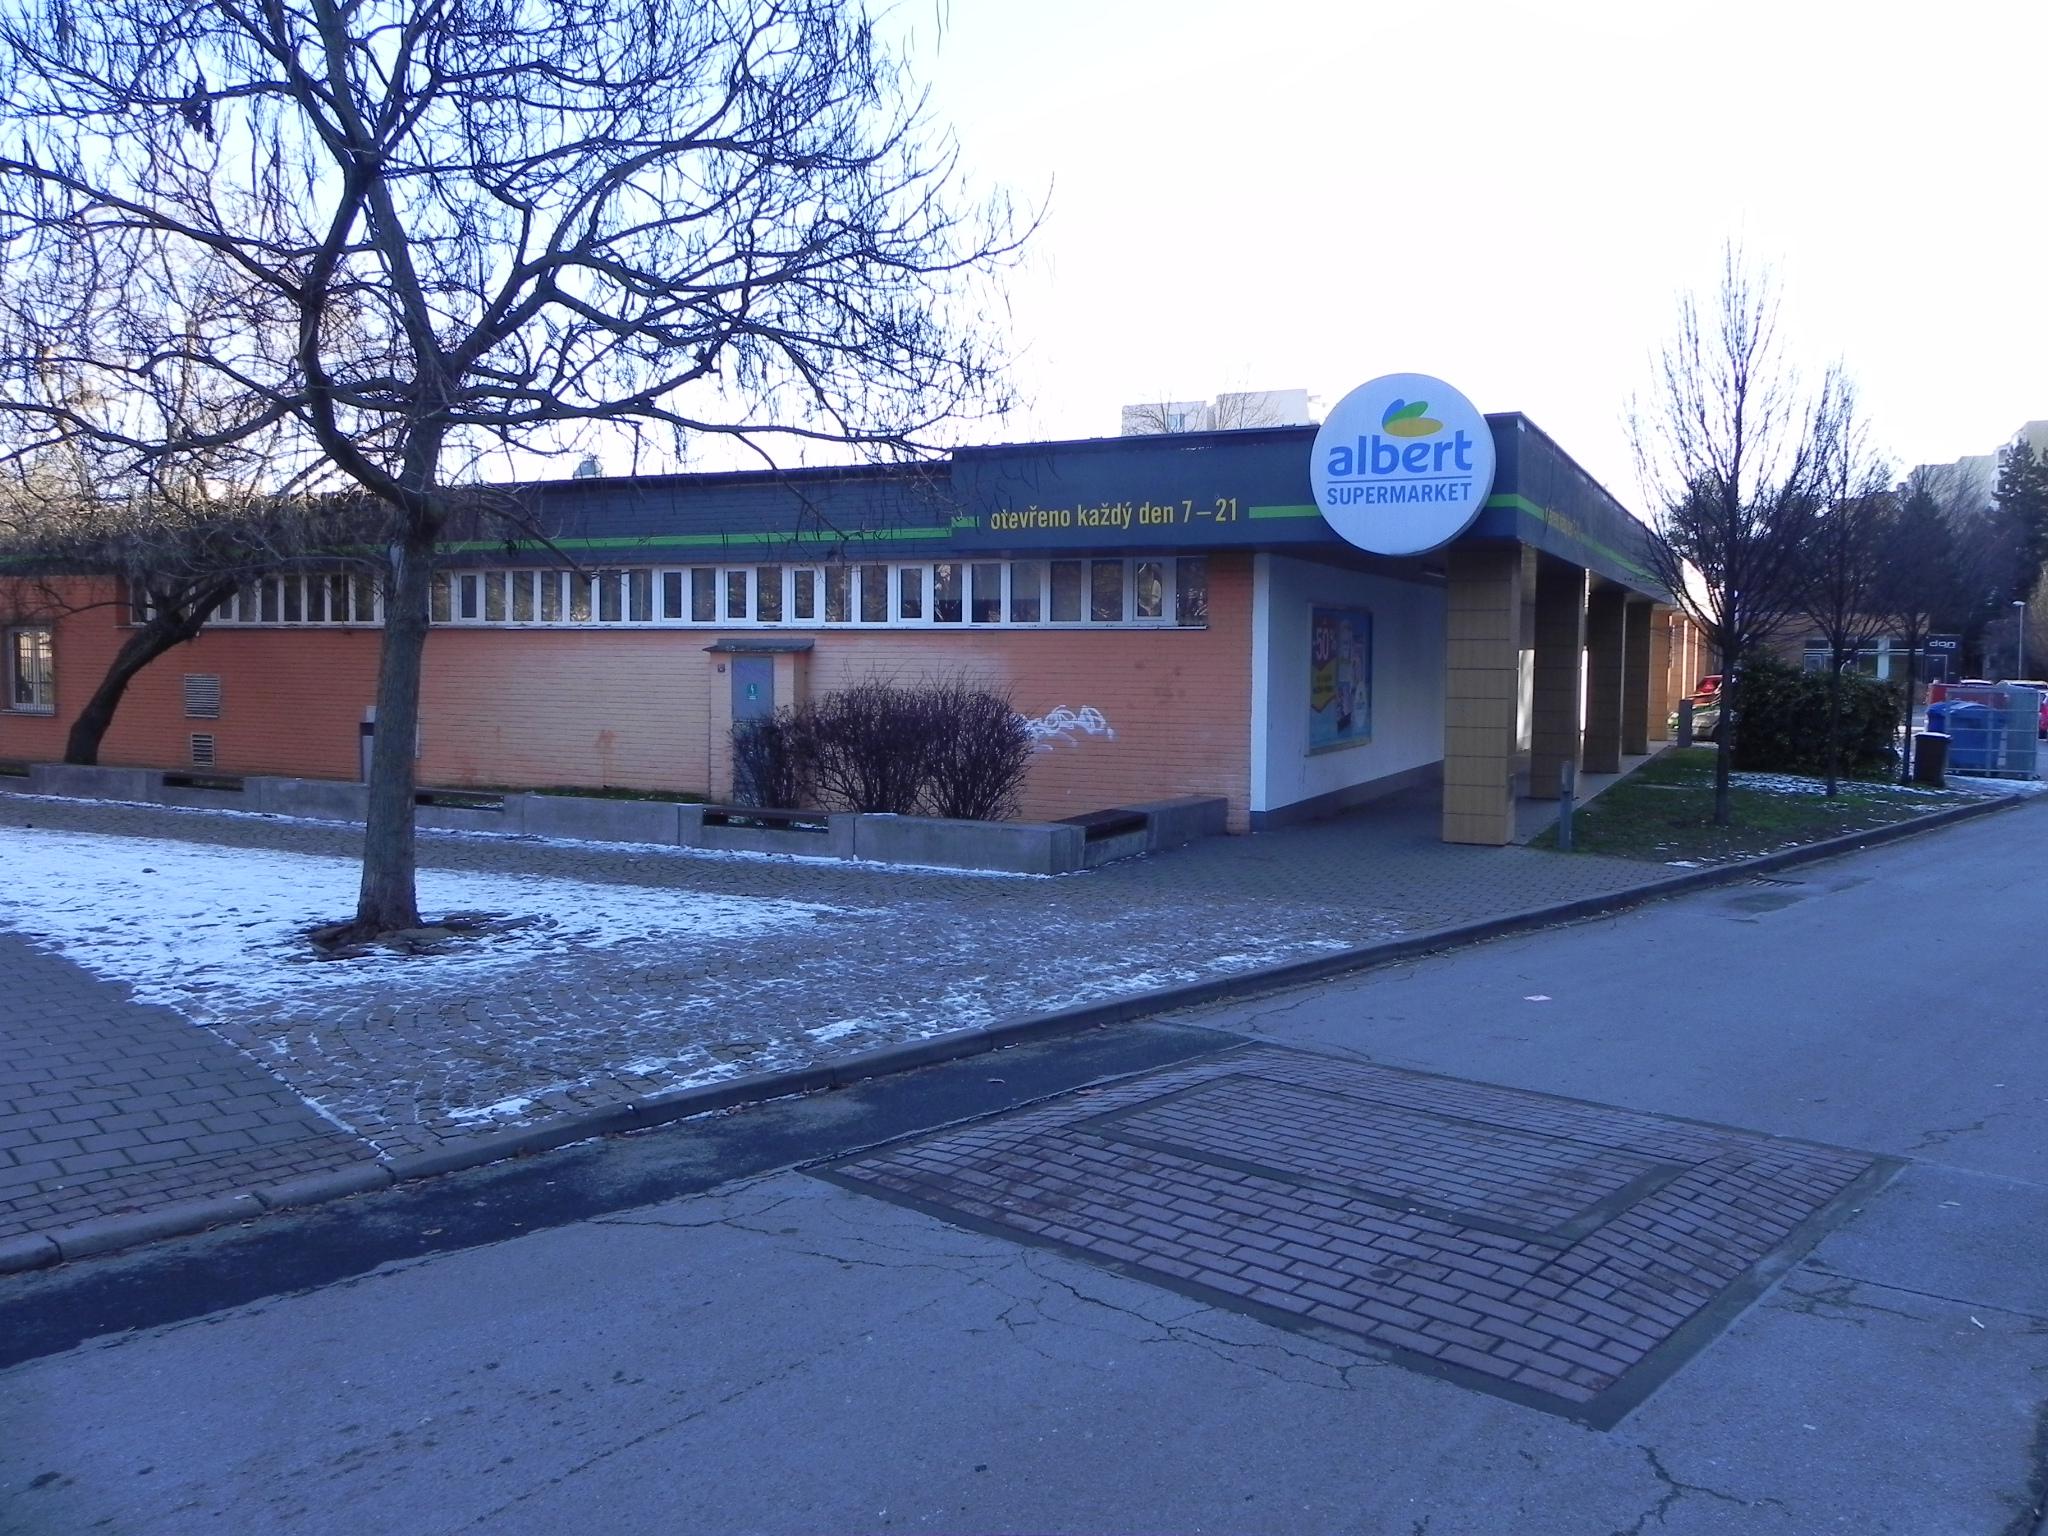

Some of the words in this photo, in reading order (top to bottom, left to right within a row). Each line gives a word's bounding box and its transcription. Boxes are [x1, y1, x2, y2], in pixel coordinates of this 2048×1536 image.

[1327, 430, 1473, 477] albert
[1327, 482, 1473, 506] SUPERMARKET
[990, 505, 1071, 530] otevřeno
[1078, 501, 1132, 530] každý
[1139, 502, 1174, 525] den
